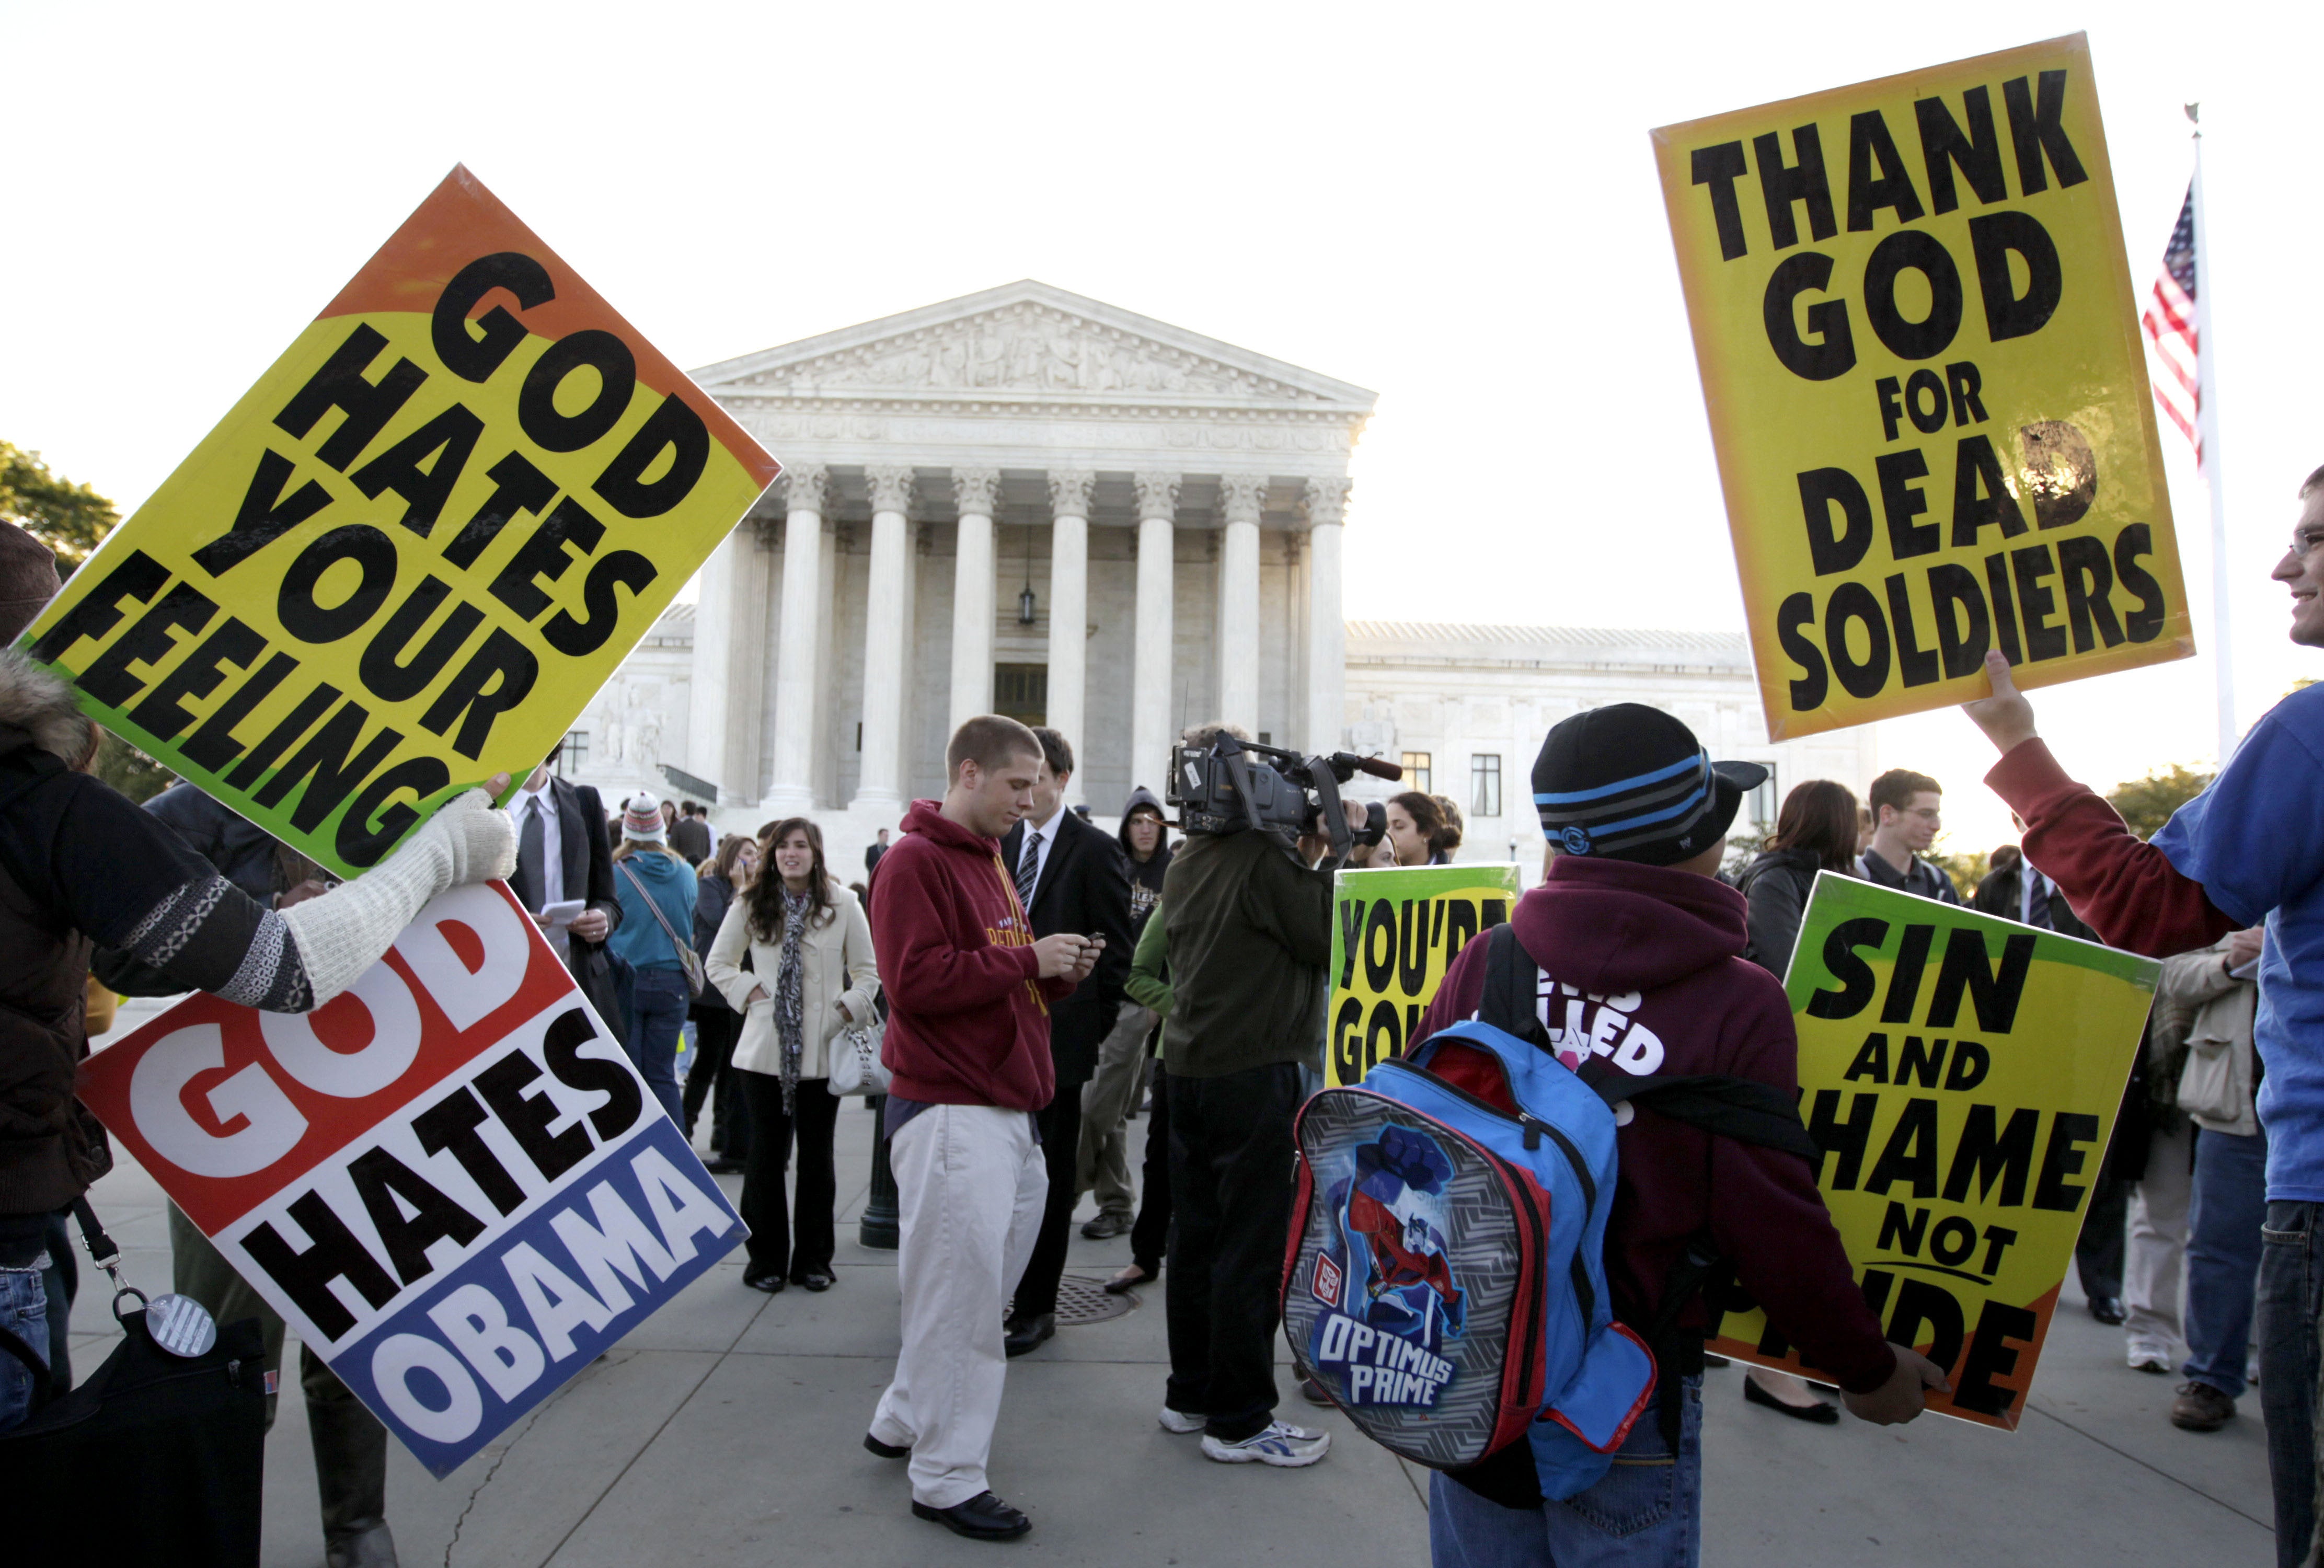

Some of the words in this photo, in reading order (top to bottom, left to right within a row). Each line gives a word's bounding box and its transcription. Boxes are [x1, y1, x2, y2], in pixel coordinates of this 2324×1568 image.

[1692, 70, 2088, 261] THANK
[432, 252, 710, 518] GOD
[1764, 211, 2062, 381] GOD
[272, 322, 658, 657] HATES
[1876, 361, 1989, 442] FOR
[1797, 420, 2097, 577] DEAD
[190, 448, 539, 762] YOUR
[1778, 524, 2165, 711] SOLDIERS
[28, 549, 497, 868] FEELING
[130, 881, 530, 1178] GOD
[1806, 917, 2037, 1034] SIN
[1844, 1032, 1990, 1091] AND
[239, 1007, 642, 1343] HATES
[1797, 1087, 2099, 1212] HAME
[1876, 1201, 2017, 1276] NOT
[371, 1145, 734, 1444] OBAMA
[1319, 1313, 1453, 1385] OPTIMUS
[1350, 1364, 1438, 1405] PRIME
